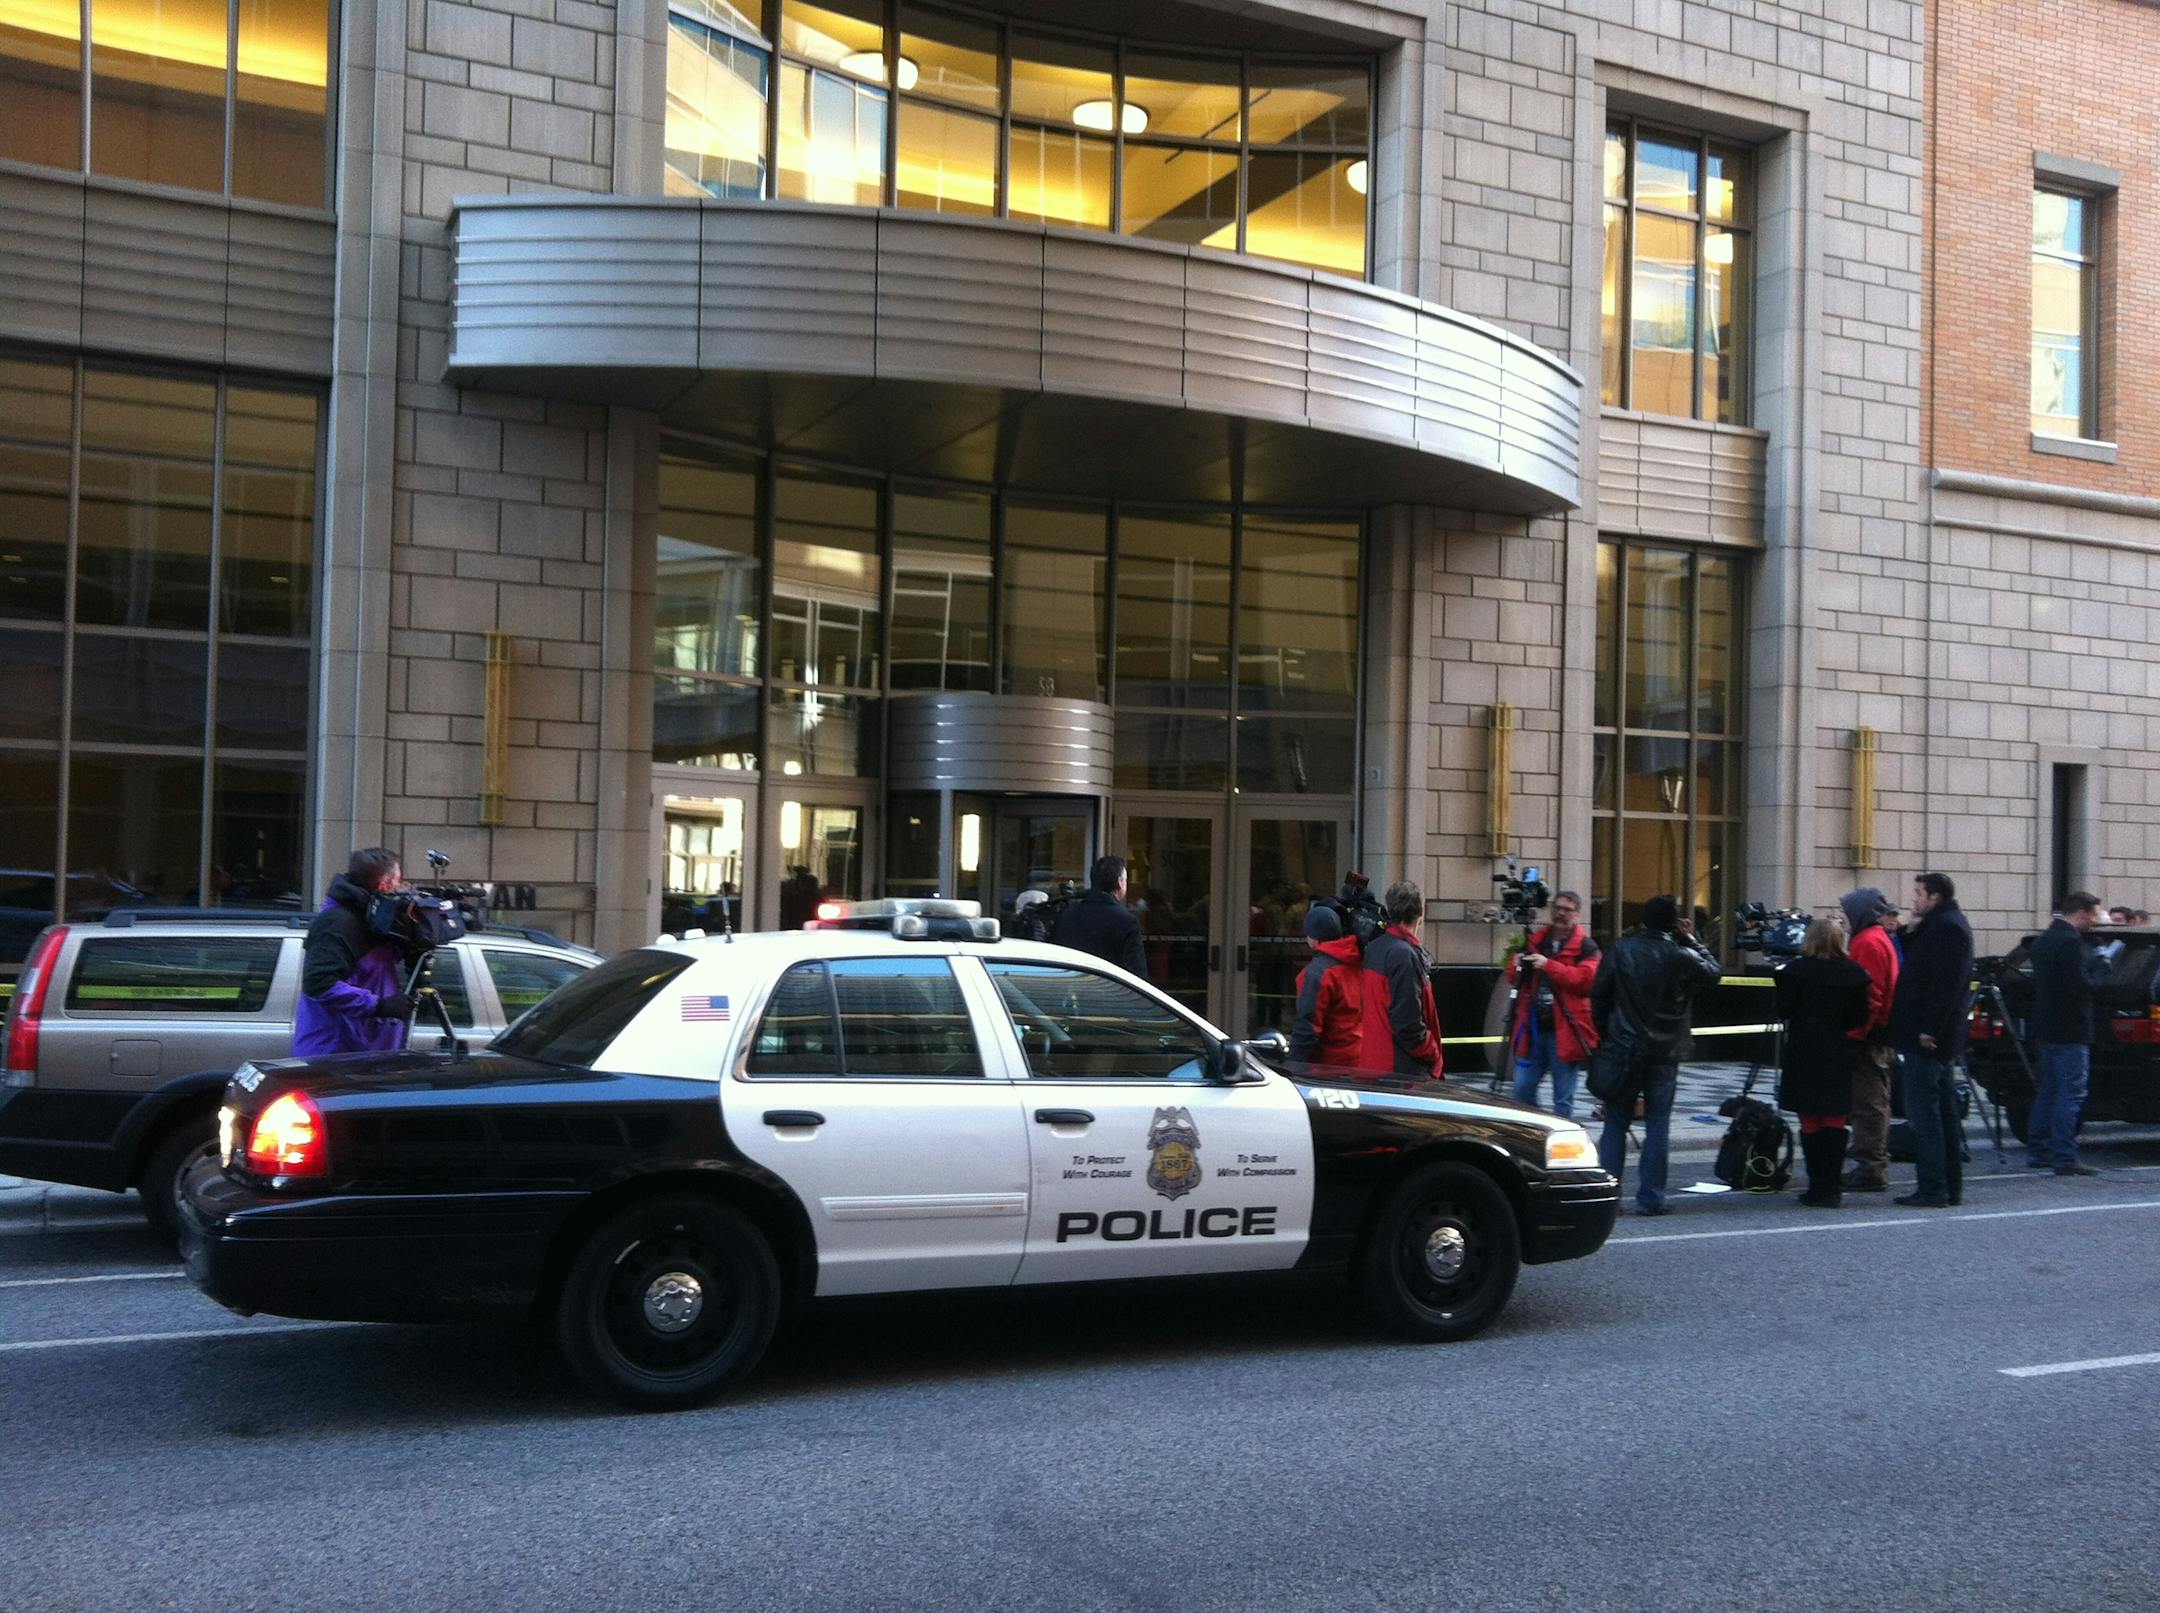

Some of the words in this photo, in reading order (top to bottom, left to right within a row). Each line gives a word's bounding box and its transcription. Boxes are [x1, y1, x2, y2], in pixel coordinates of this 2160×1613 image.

[491, 883, 536, 911] AN
[1309, 1088, 1360, 1109] 120
[1056, 1206, 1278, 1243] POLICE
